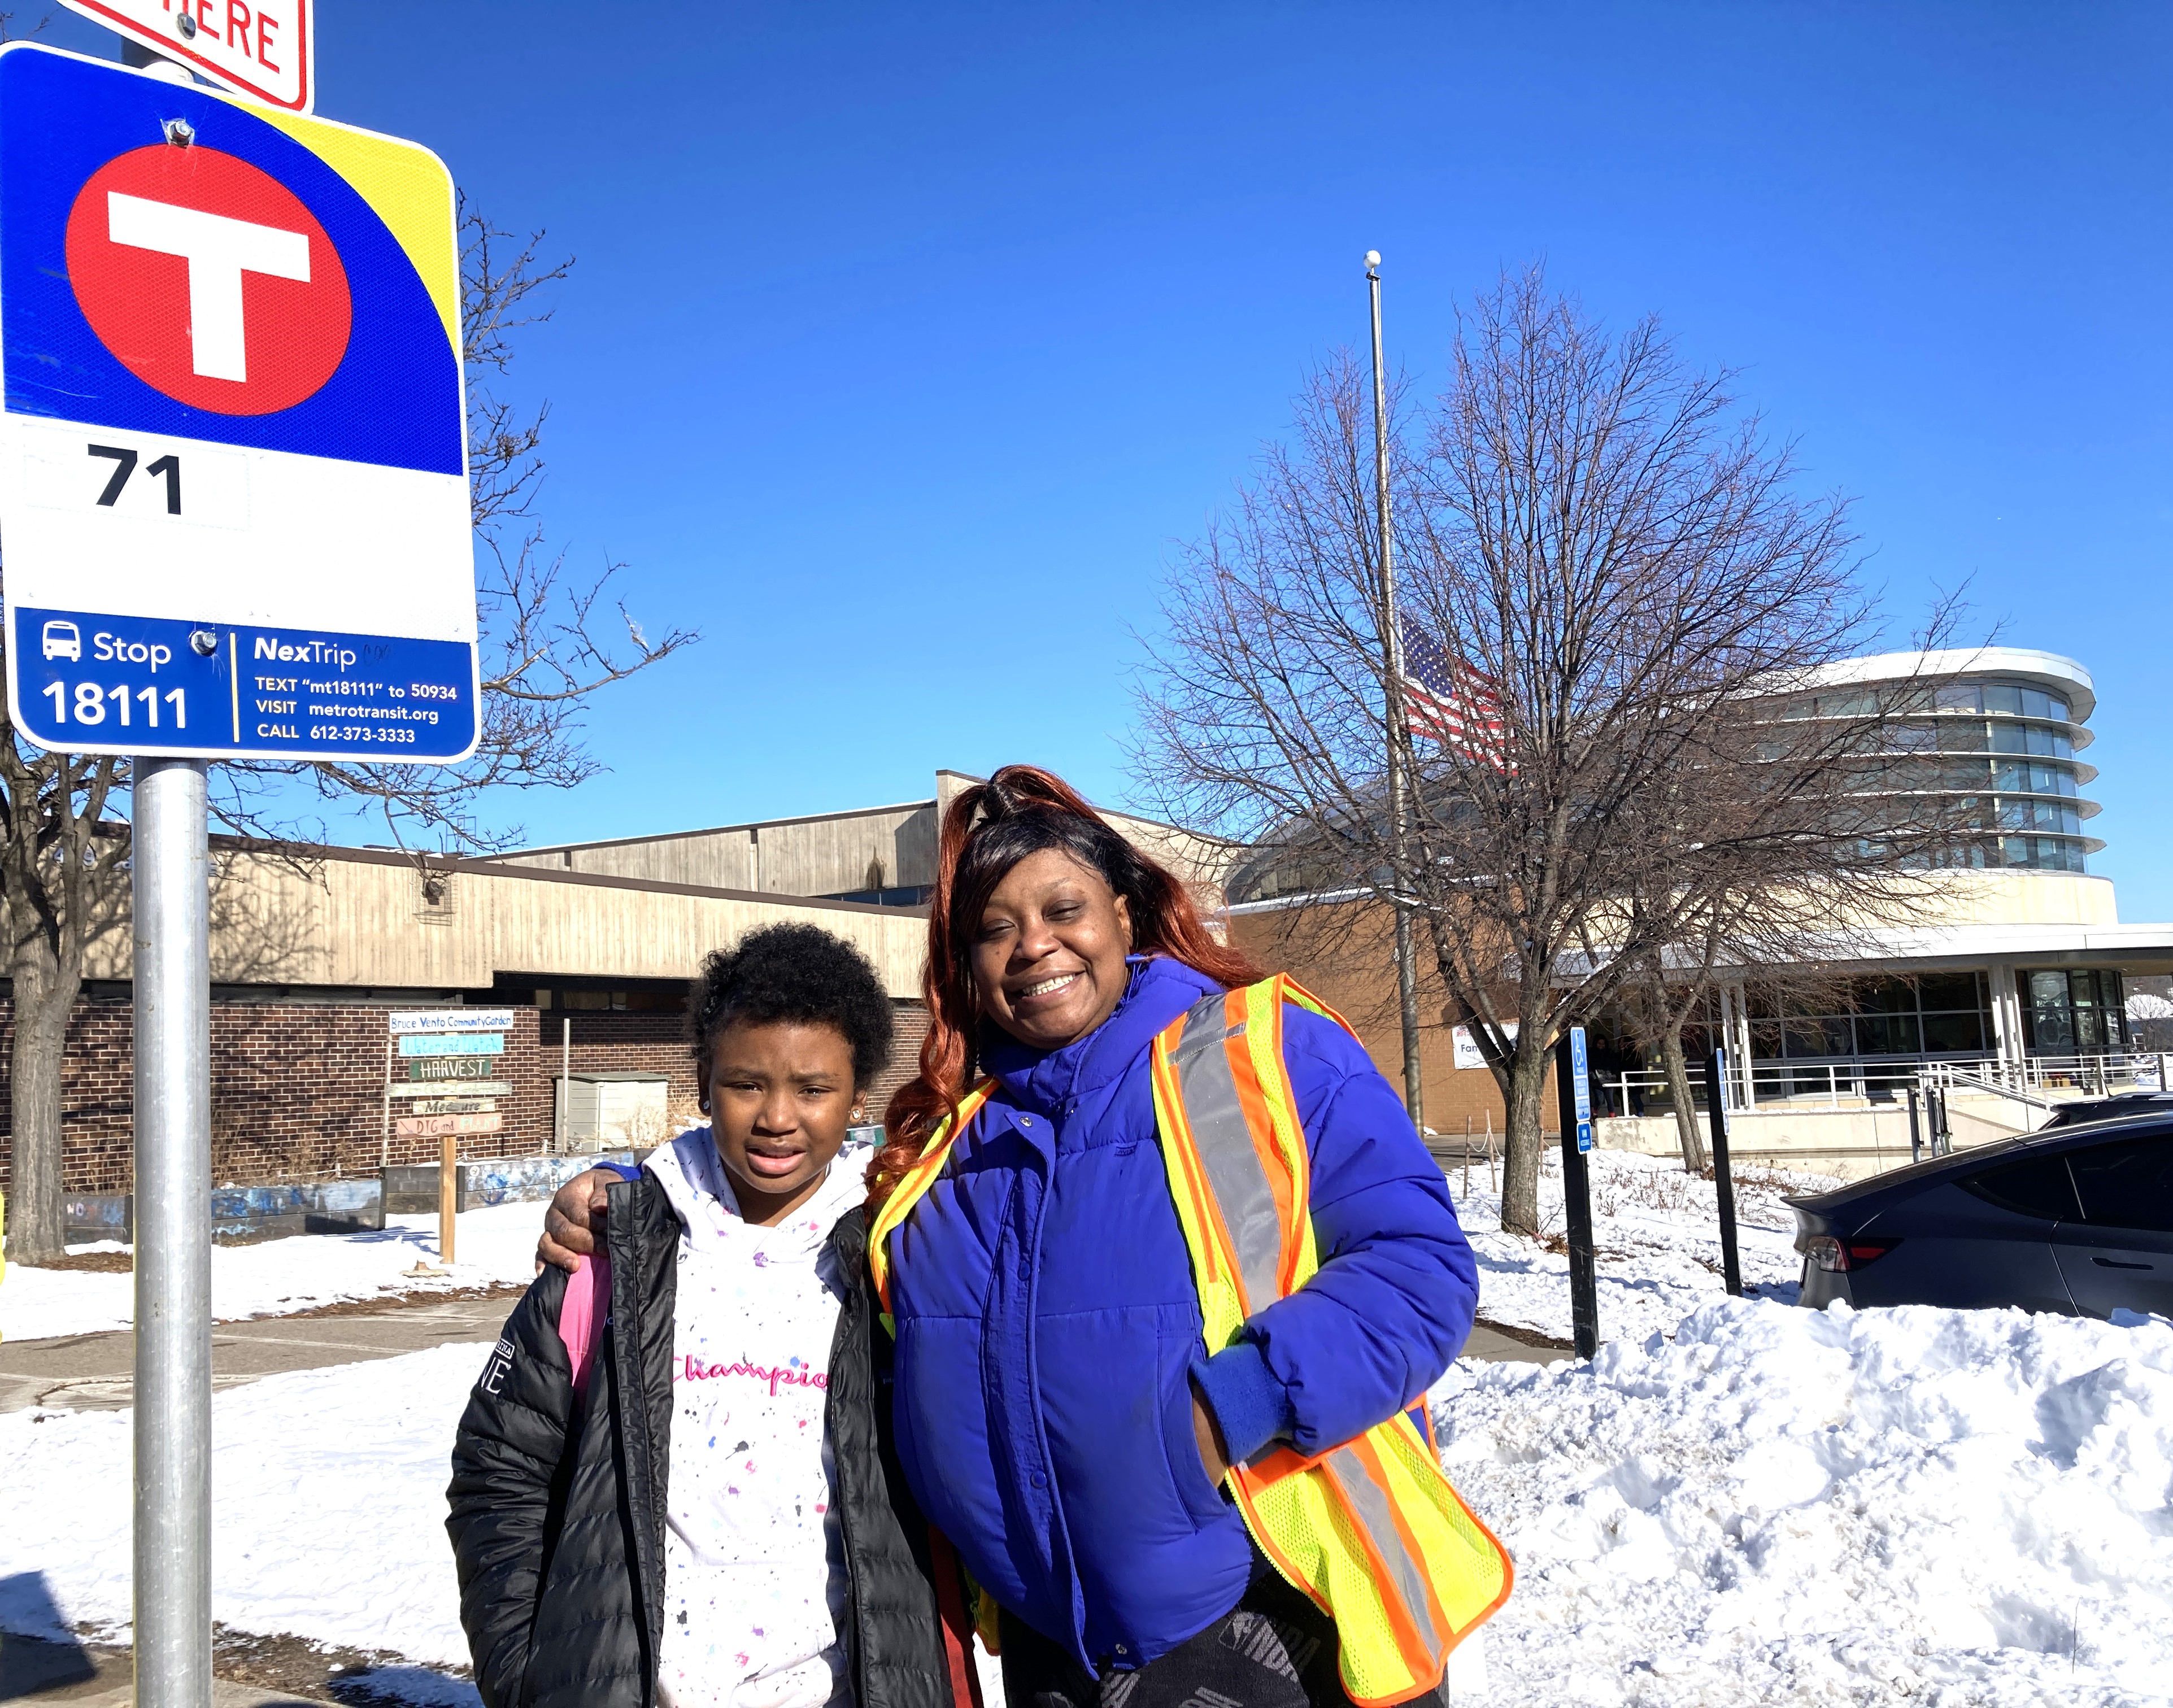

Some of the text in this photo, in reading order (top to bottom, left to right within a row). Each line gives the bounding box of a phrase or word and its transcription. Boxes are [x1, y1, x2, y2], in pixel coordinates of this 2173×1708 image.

[163, 0, 280, 74] ERE
[87, 443, 181, 515] 71
[93, 632, 171, 673] Stop
[254, 637, 356, 673] NexTrip
[255, 677, 458, 700] TEXT “mt18111” to 50934
[42, 681, 186, 729] 18111
[255, 699, 439, 725] VISIT metrotransit.org
[257, 724, 415, 743] CALL 612-373-3333
[391, 1018, 417, 1029] Bruce
[419, 1016, 446, 1027] Vento
[406, 1037, 499, 1055] Water and Watch
[420, 1059, 485, 1078] HARVEST
[425, 1101, 481, 1113] Meure
[416, 1119, 438, 1135] DIG
[441, 1119, 454, 1131] and
[673, 1354, 828, 1397] hampio
